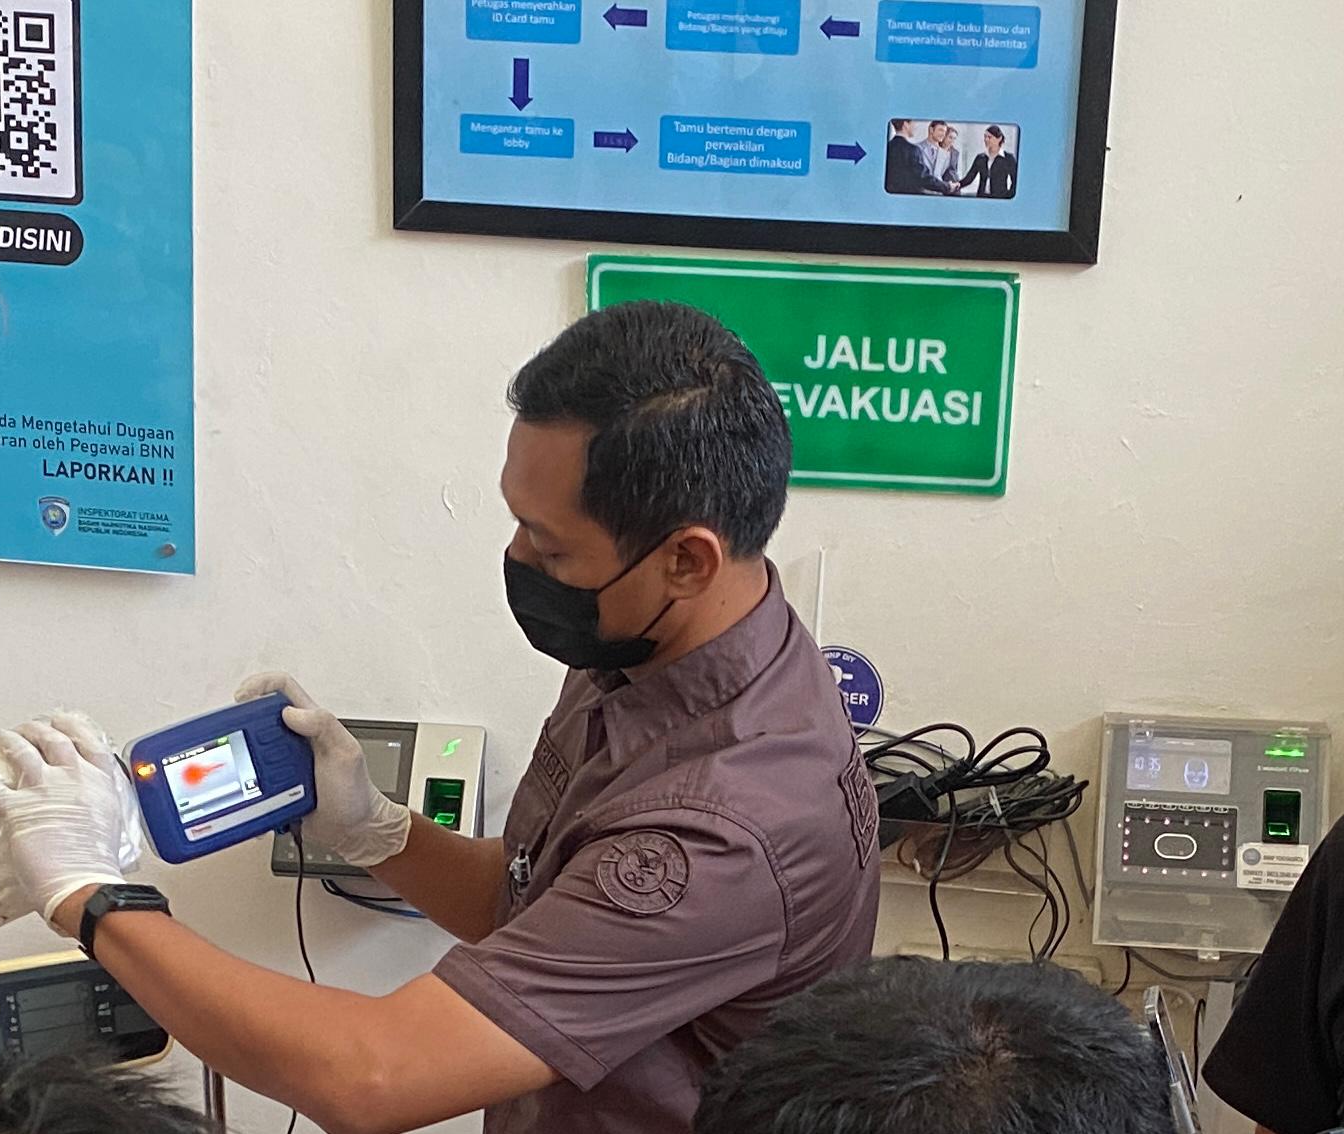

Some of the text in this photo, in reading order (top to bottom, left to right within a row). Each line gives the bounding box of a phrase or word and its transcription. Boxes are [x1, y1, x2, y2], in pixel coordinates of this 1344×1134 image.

[505, 13, 527, 23] Card
[530, 15, 555, 24] tamu
[886, 19, 1031, 35] Tamu Mengisi buku tamu dan
[525, 124, 550, 136] tamu
[553, 126, 564, 137] ke
[674, 121, 797, 140] Tamu bertemu dengan
[503, 137, 531, 150] lobby
[705, 139, 765, 153] perwakilan
[666, 152, 802, 170] Bidang/Bagian dimaksud
[803, 334, 948, 375] JALUR
[22, 415, 112, 436] Mengetahui
[116, 422, 175, 443] Dugaan
[32, 434, 66, 451] oleh
[70, 438, 135, 457] Pegawai
[140, 443, 175, 460] BNN
[43, 459, 174, 487] LAPORKAN !!
[139, 511, 169, 522] UTAMA
